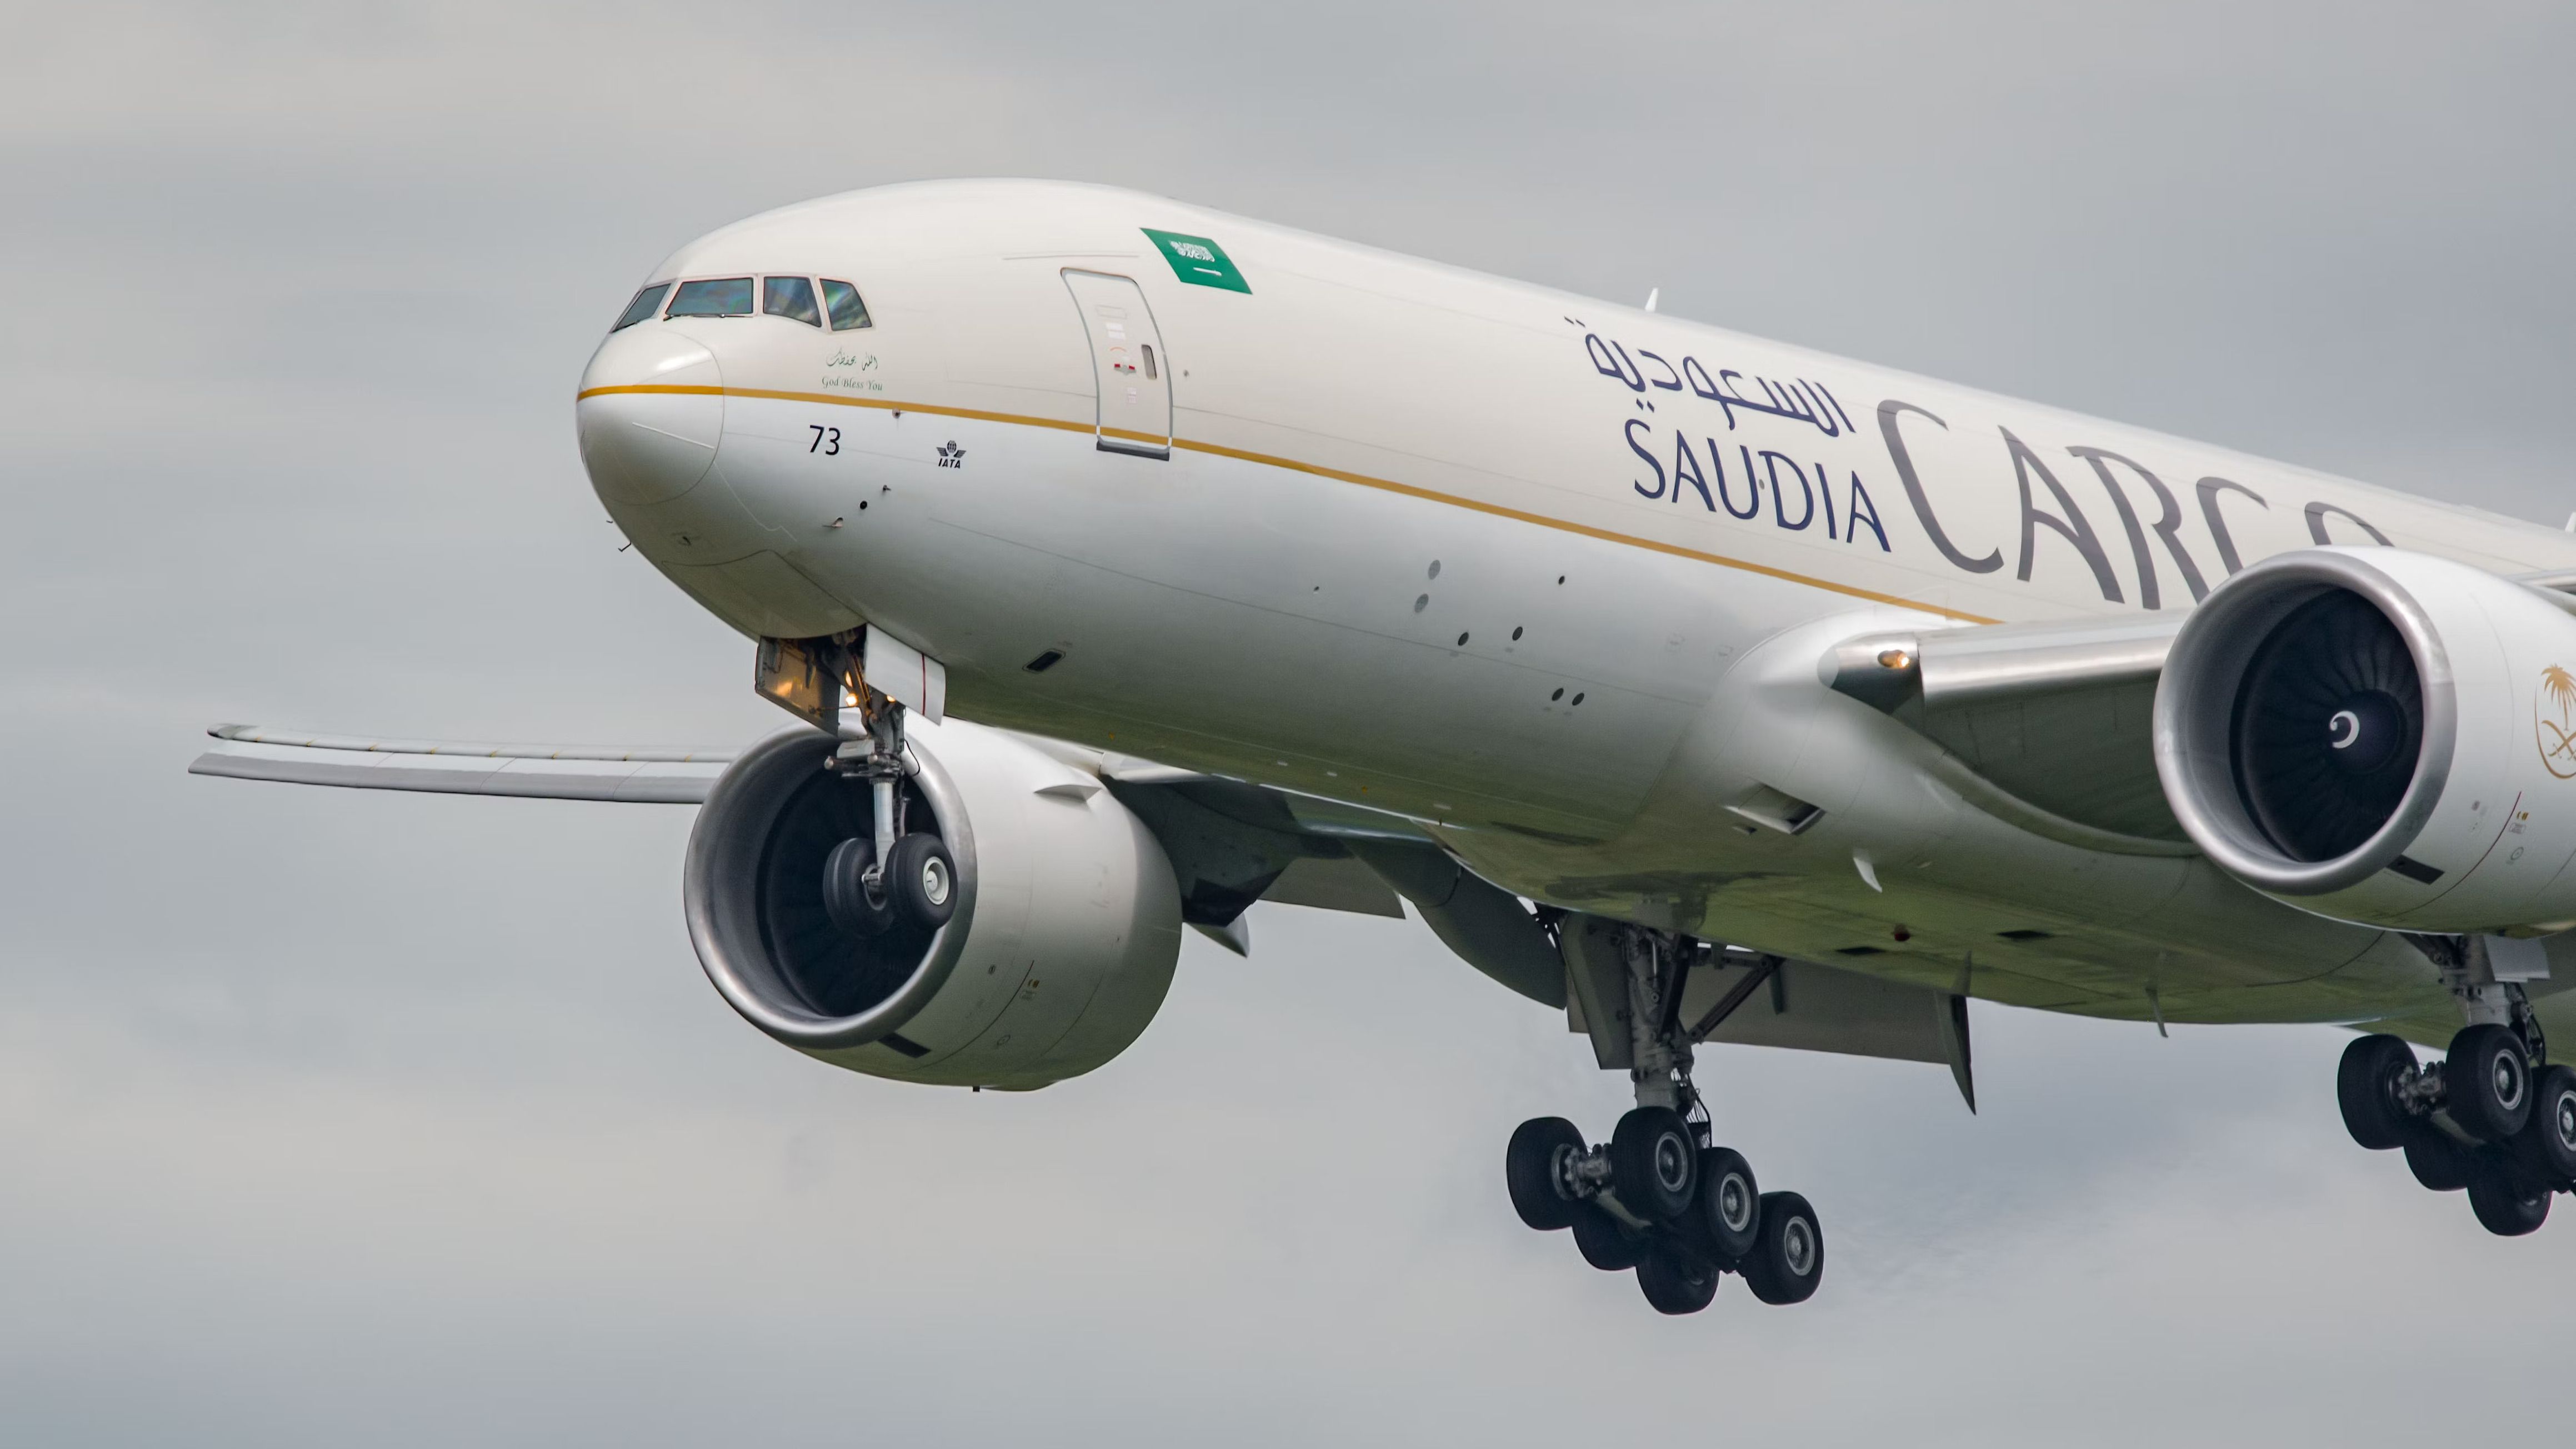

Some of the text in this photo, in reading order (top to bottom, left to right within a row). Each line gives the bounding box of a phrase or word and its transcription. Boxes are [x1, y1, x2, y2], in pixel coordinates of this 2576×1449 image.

[822, 376, 883, 391] God Bless You
[1564, 316, 1856, 437] السعودية
[809, 424, 841, 456] 73
[938, 457, 961, 469] IATA
[1624, 418, 1891, 553] SAUDIA
[1877, 399, 2395, 610] CAR
